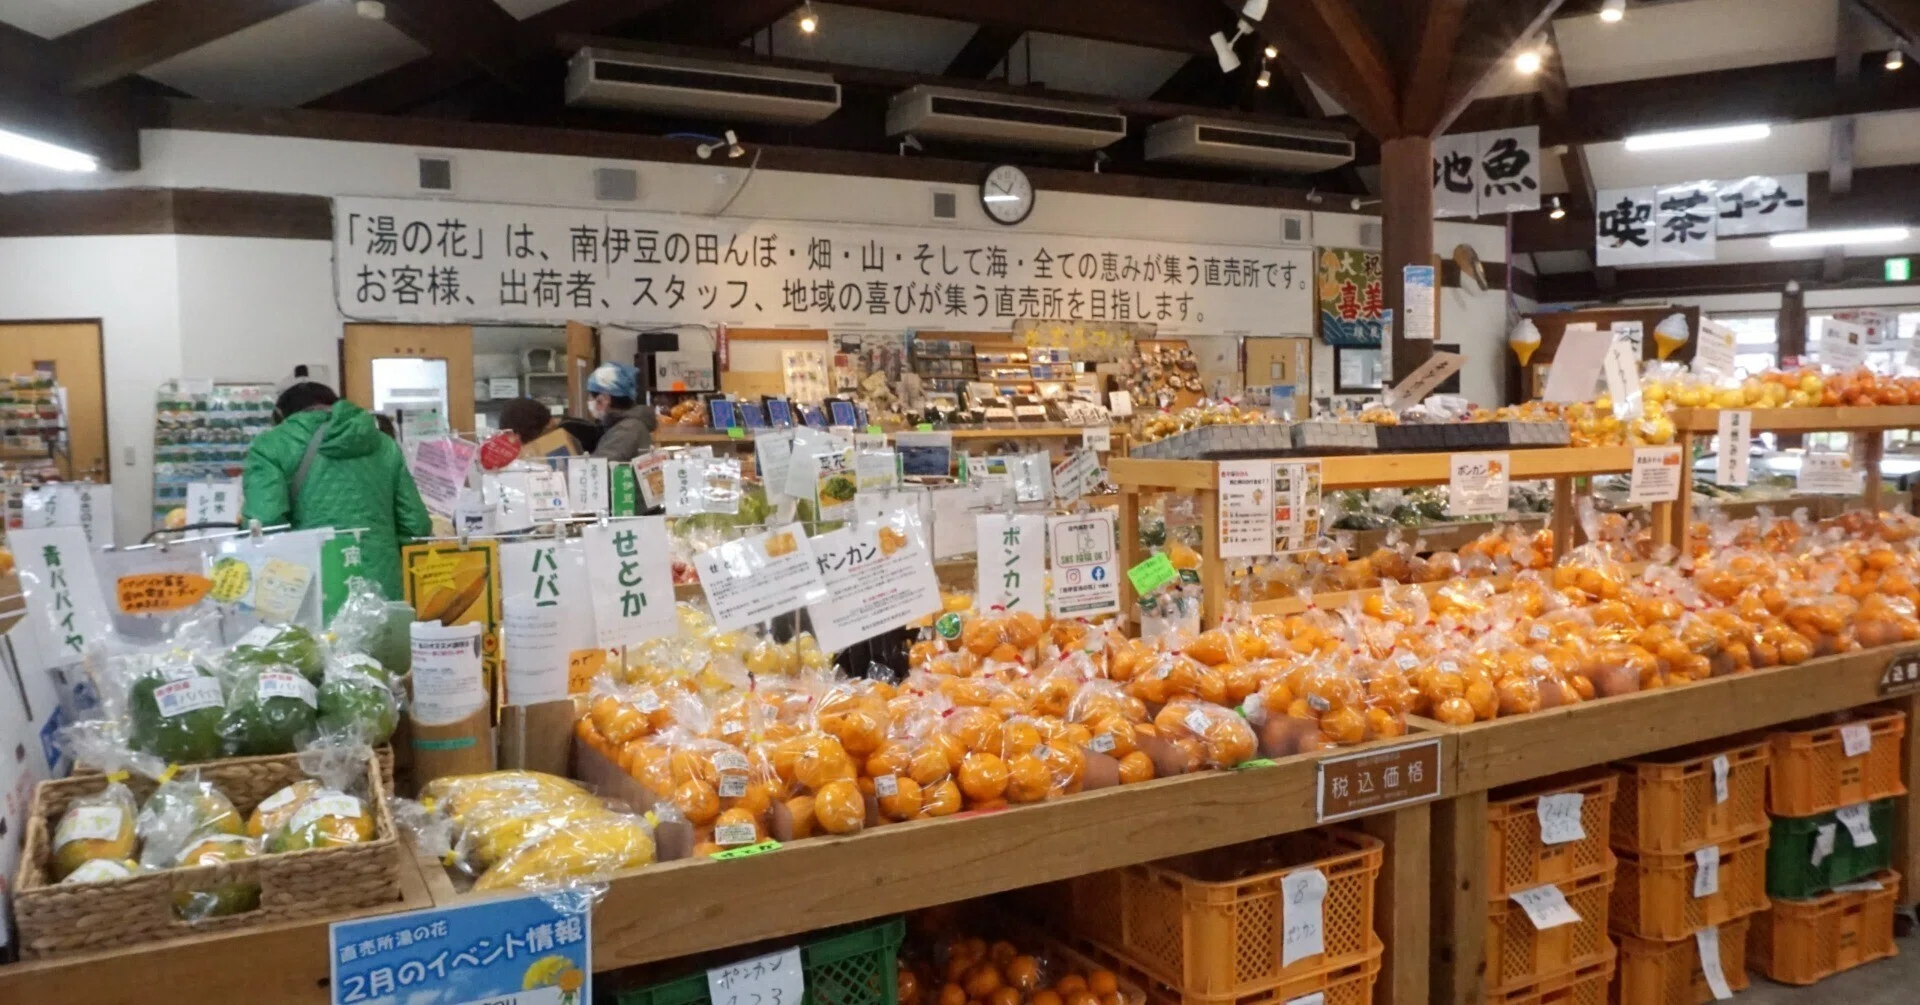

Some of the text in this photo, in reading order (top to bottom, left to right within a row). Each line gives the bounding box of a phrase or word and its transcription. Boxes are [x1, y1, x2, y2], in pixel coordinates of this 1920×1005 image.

[1433, 137, 1537, 197] 地魚
[356, 263, 1204, 323] お客様、出荷者、スタッフ、地域の喜びが集う直売所を目指します。
[532, 547, 560, 608] ババ
[612, 529, 647, 617] せとか
[816, 543, 877, 575] ポンカン
[1003, 526, 1021, 609] ポンカン
[43, 545, 83, 653] 青パパイヤ
[1332, 760, 1424, 799] 税込価格
[339, 919, 448, 964] 直売所湯の花
[343, 916, 583, 1003] 2月のイベント情報
[720, 956, 783, 990] ポンカン
